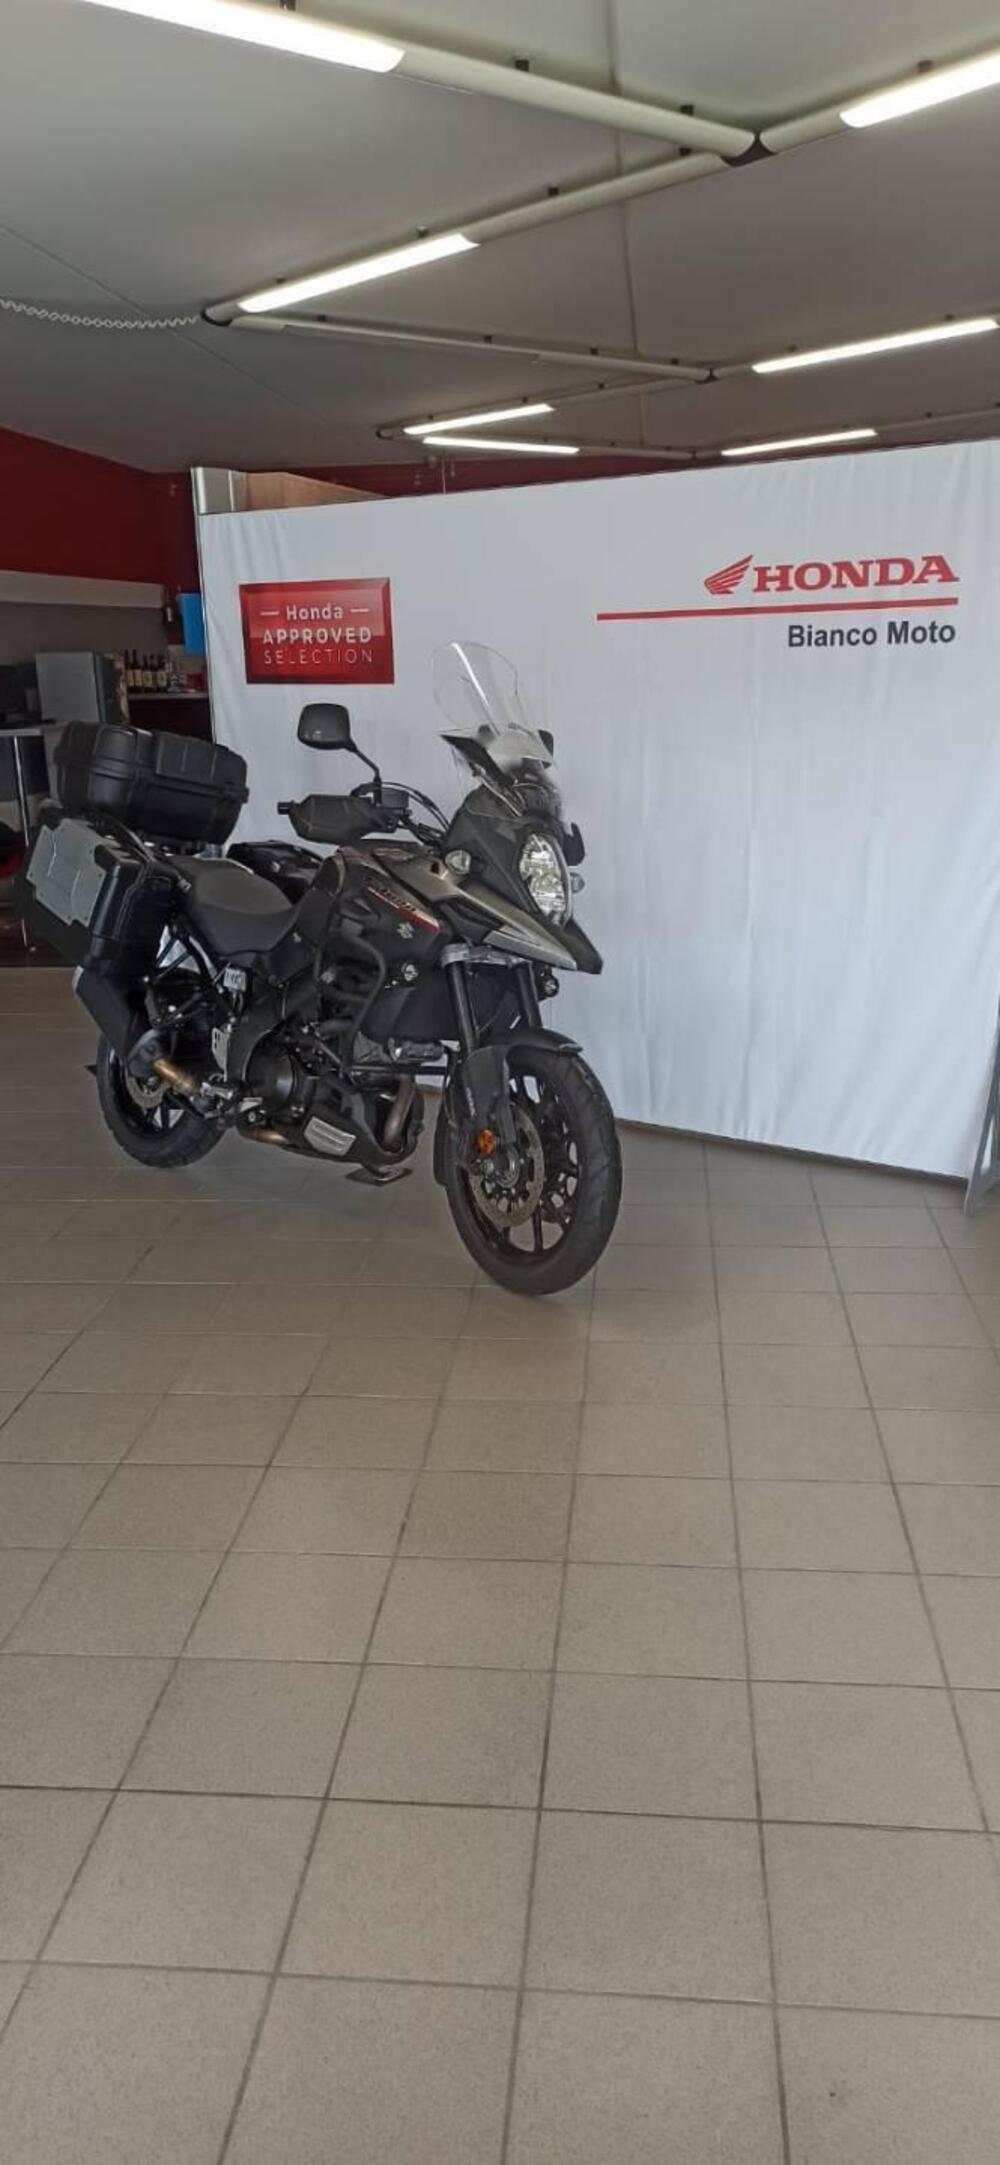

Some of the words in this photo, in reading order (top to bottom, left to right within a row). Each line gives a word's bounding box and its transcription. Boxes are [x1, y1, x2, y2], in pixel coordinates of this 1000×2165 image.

[753, 555, 959, 592] HONDA
[286, 603, 343, 620] Honda
[262, 627, 372, 644] APPROVED
[788, 624, 877, 647] Bianco
[886, 621, 956, 645] Moto
[264, 649, 373, 664] SELECTION
